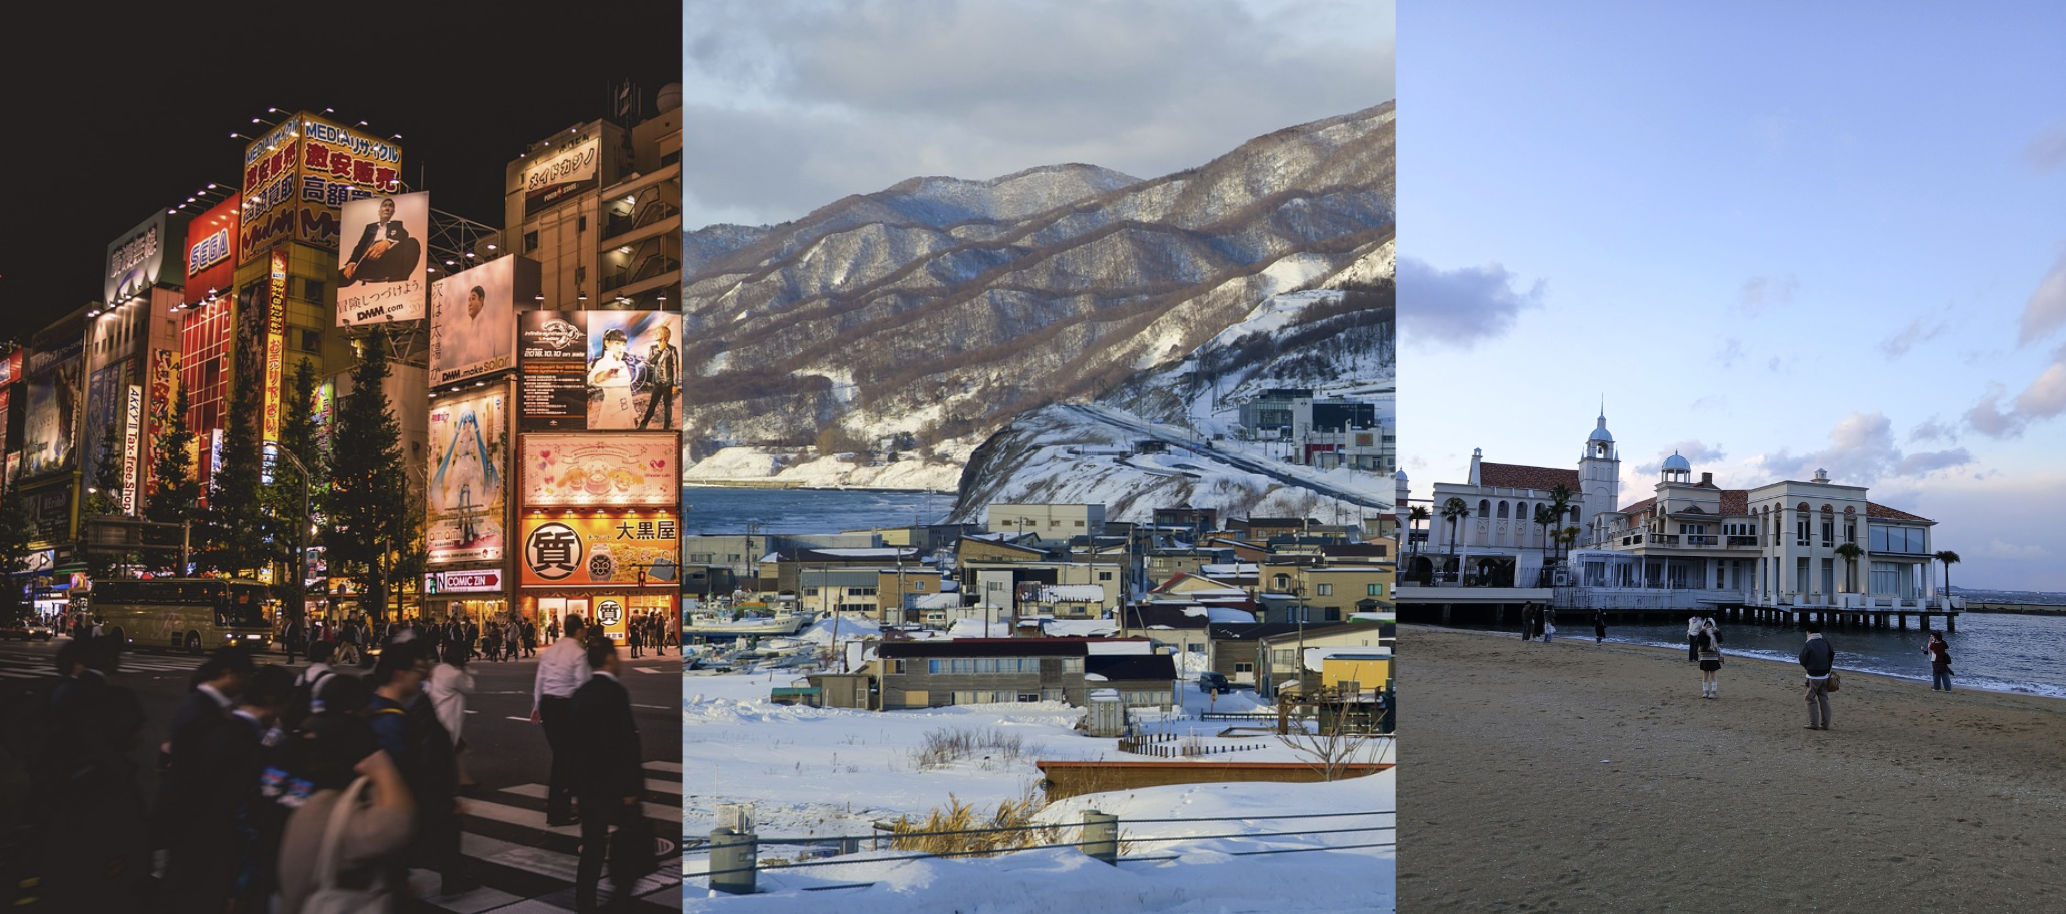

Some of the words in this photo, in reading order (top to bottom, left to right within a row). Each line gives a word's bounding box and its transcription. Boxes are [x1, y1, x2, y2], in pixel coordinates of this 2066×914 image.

[304, 141, 398, 193] 激安販売
[188, 227, 231, 277] SEGA
[337, 280, 423, 314] 冒険しつづけよう。
[357, 303, 404, 321] DMM.com
[430, 282, 443, 385] 次は太陽か。
[484, 356, 509, 371] solar
[128, 387, 140, 422] AKKY
[122, 481, 135, 510] Shop
[616, 521, 676, 540] 大黒屋
[533, 531, 575, 573] 質
[448, 576, 473, 586] COMIC
[474, 575, 486, 586] ZIN
[600, 603, 620, 621] 質
